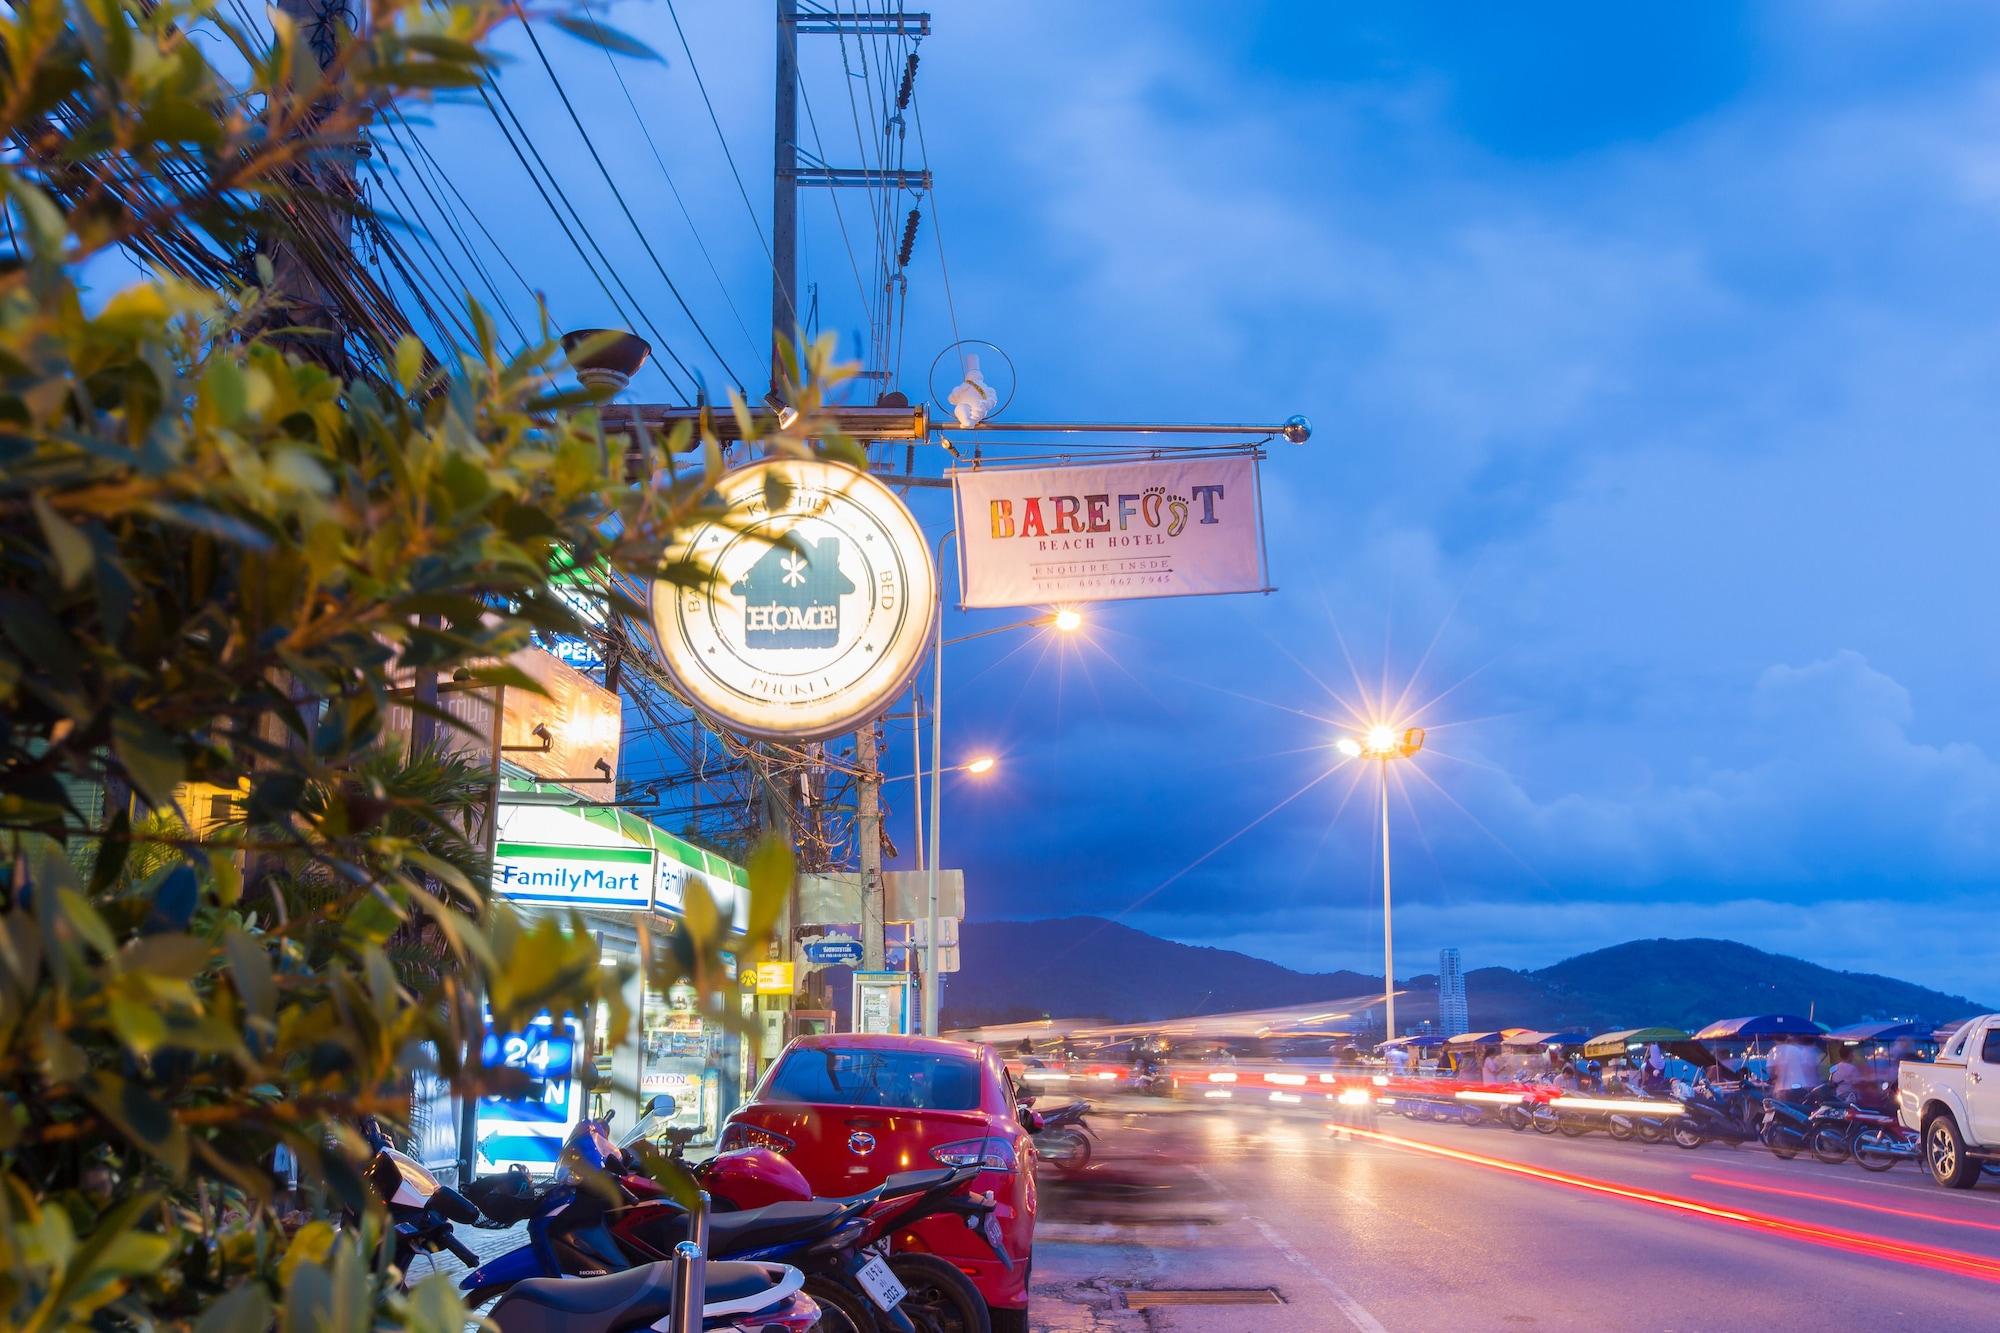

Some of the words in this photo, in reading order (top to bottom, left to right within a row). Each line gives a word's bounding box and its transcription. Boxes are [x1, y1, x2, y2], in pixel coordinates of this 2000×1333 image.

[747, 496, 839, 517] KIHEN
[1039, 539, 1094, 551] BEACH
[1109, 534, 1165, 547] HOTEL
[879, 570, 895, 611] BED
[746, 605, 838, 632] HOME
[552, 641, 602, 662] PEN
[503, 865, 639, 892] FamilyMart
[504, 1037, 549, 1071] 24
[883, 1285, 900, 1303] 303
